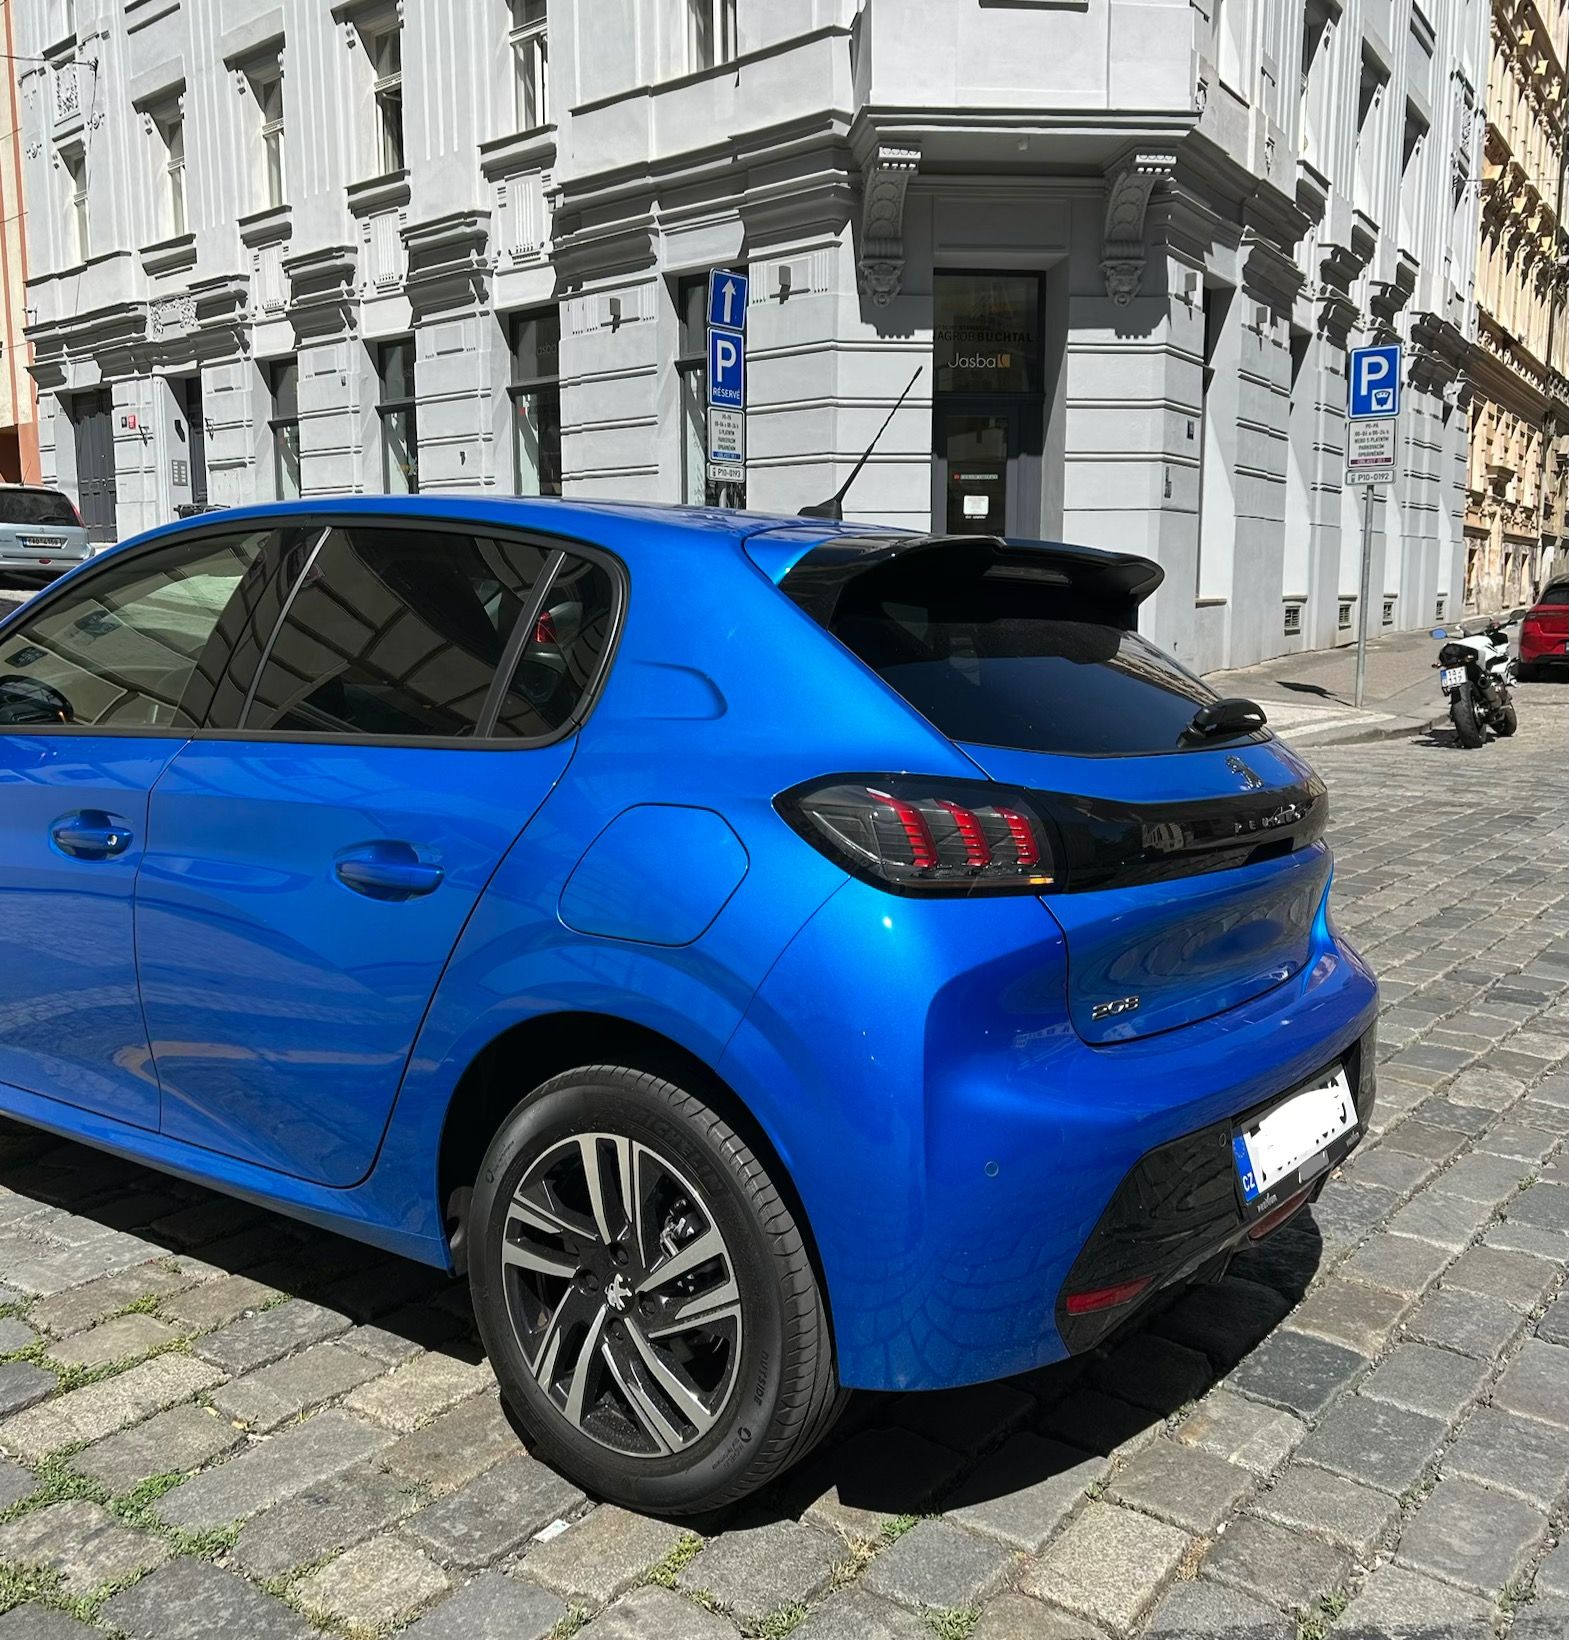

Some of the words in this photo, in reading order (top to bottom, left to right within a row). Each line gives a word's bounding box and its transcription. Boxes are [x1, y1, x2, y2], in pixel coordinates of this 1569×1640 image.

[717, 339, 737, 382] P
[948, 352, 996, 368] Jasba
[1360, 355, 1389, 396] P
[713, 385, 741, 400] RÉSERVÉ
[1358, 473, 1389, 481] P10-0192
[1091, 995, 1140, 1020] 208
[1242, 1171, 1256, 1192] CZ
[754, 1350, 769, 1406] OUTSIDE
